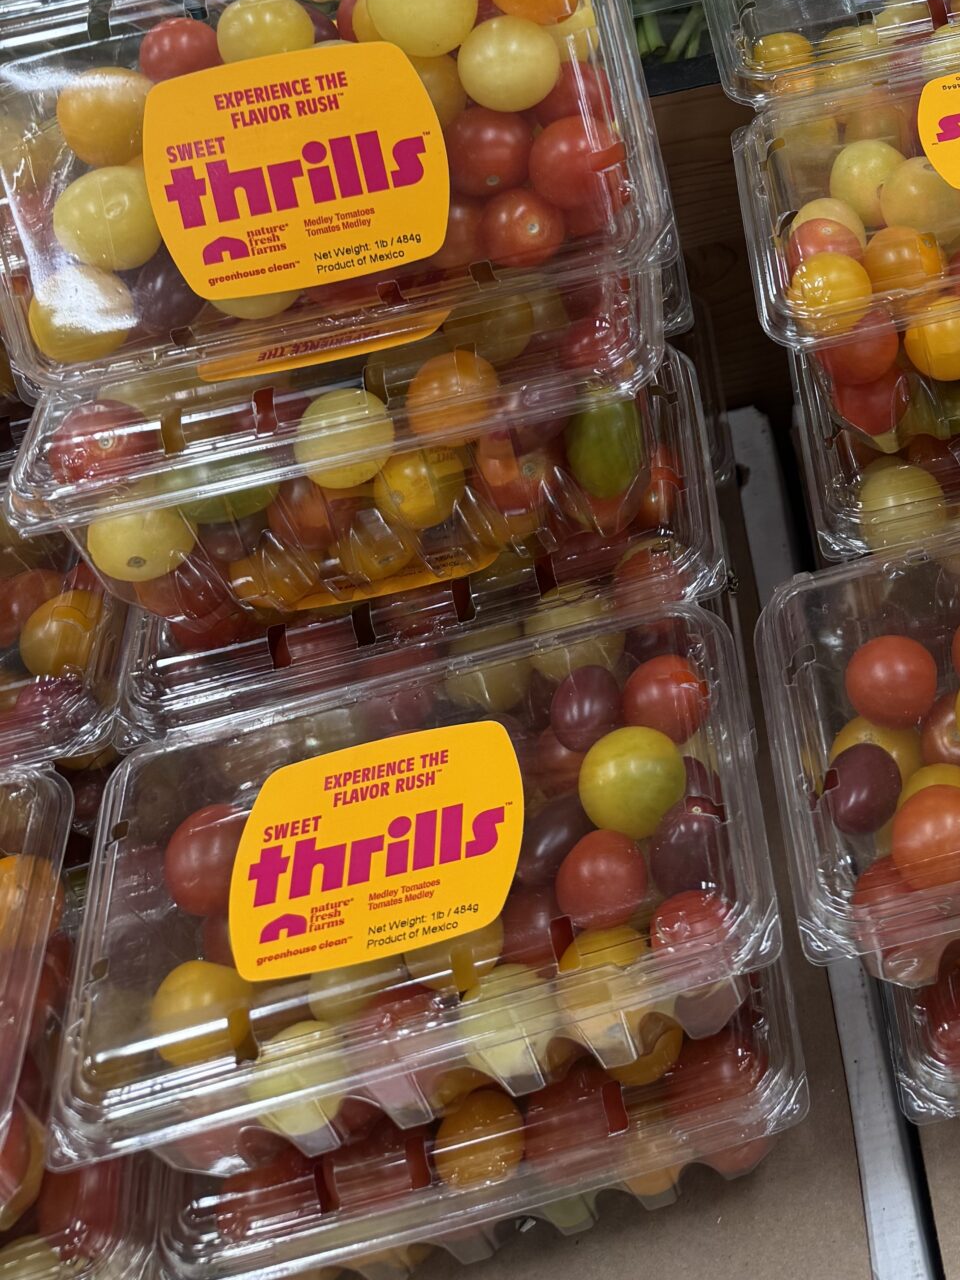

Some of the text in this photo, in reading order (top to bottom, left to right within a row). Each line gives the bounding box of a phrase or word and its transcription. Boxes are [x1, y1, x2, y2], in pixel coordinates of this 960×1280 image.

[213, 71, 348, 111] EXPERIENCE THE
[230, 103, 292, 129] FLAVOR
[166, 136, 225, 164] SWEET
[303, 207, 376, 228] Medley Tomatoes
[341, 218, 372, 231] Medley
[247, 231, 281, 248] fresh
[250, 240, 287, 257] farms
[313, 250, 333, 262] Net
[396, 233, 422, 244] 484g
[316, 258, 356, 275] Product
[369, 250, 405, 264] Mexico
[207, 267, 267, 287] greenhouse
[324, 749, 449, 792] EXPERIENCE THE
[333, 781, 390, 808] FLAVOR
[263, 815, 322, 843] SWEET
[368, 878, 441, 902] Medley Tomatoes
[404, 890, 435, 903] Medley
[308, 915, 345, 933] farms
[309, 906, 342, 925] fresh
[367, 923, 387, 936] Net
[453, 903, 479, 915] 484g
[366, 931, 407, 949] Product
[421, 921, 459, 936] Mexico
[255, 944, 318, 967] greenhouse
